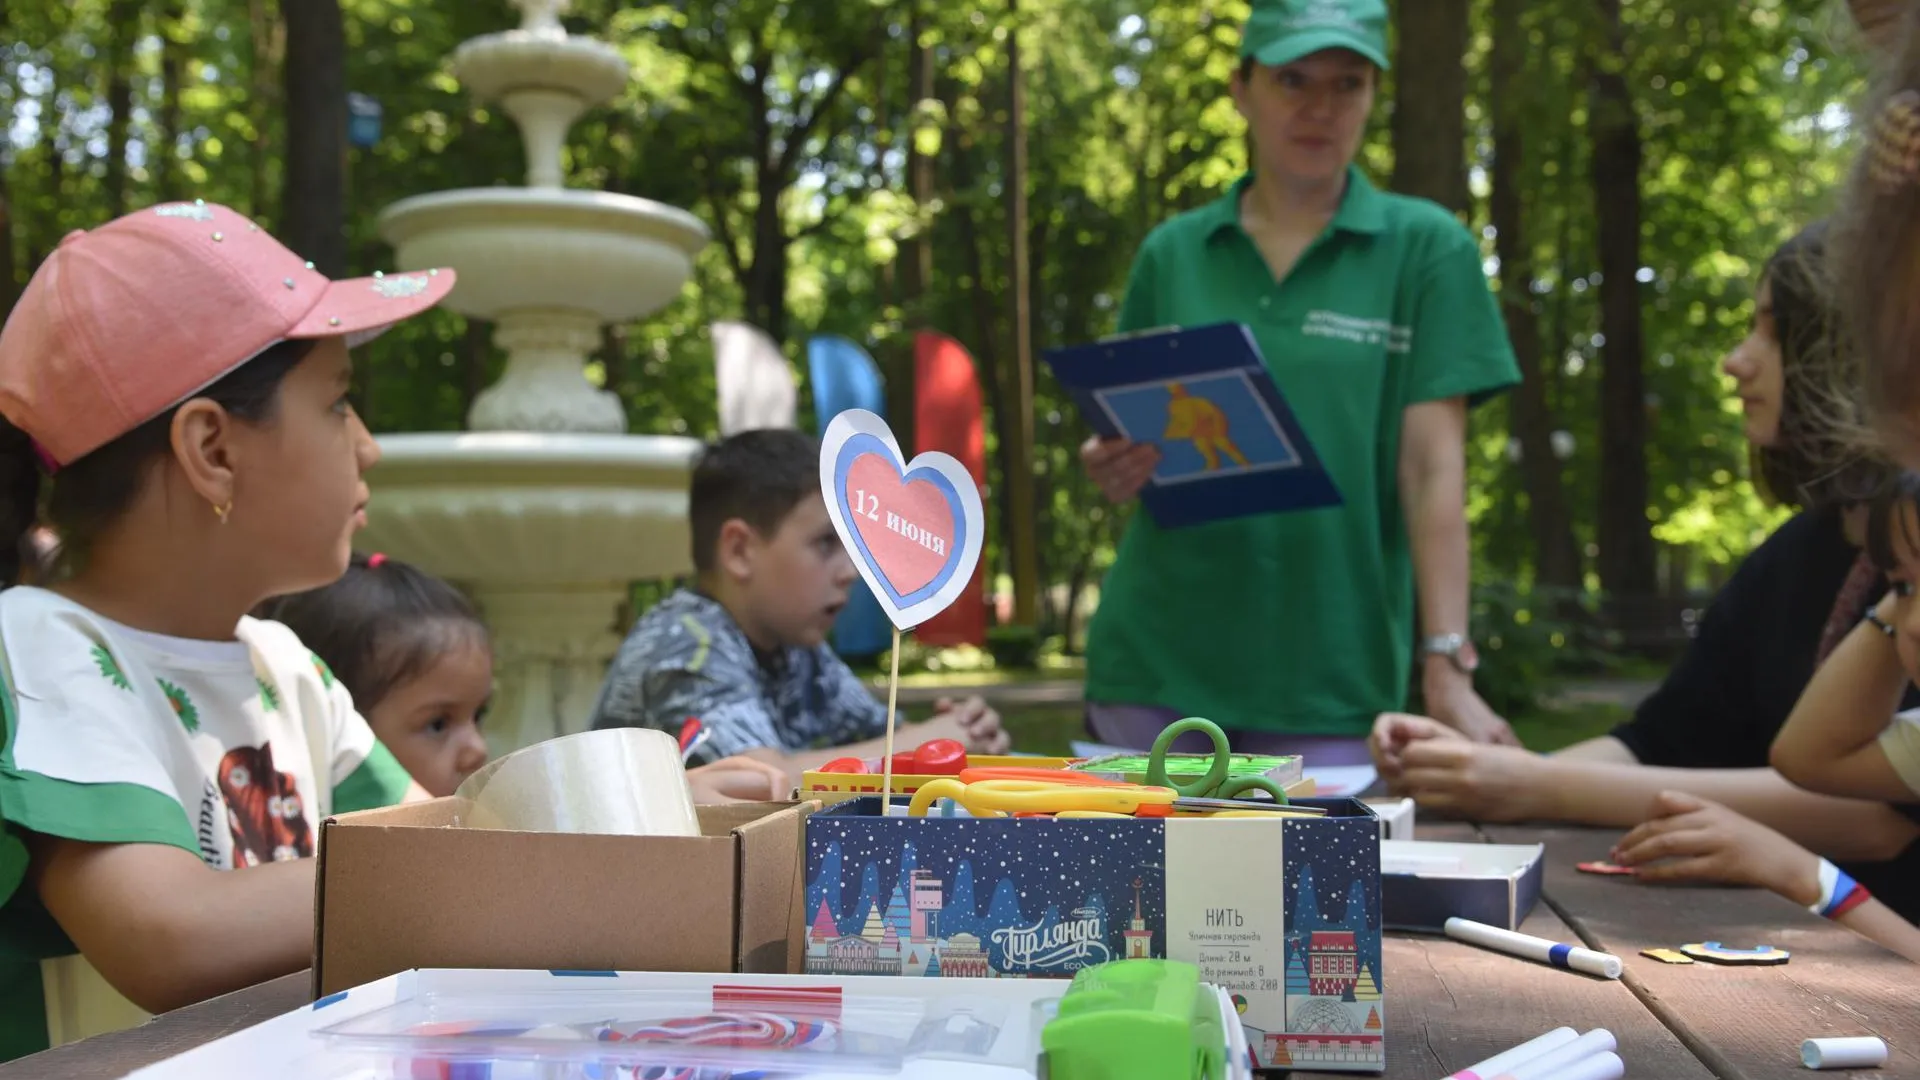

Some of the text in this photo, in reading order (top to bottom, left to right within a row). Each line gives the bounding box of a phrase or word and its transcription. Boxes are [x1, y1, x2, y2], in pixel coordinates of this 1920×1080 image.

[855, 490, 945, 556] 12 июня
[1206, 908, 1243, 927] НИТЬ
[991, 918, 1106, 970] Гирлянда
[1199, 953, 1226, 963] Длина:
[1260, 979, 1278, 990] 200
